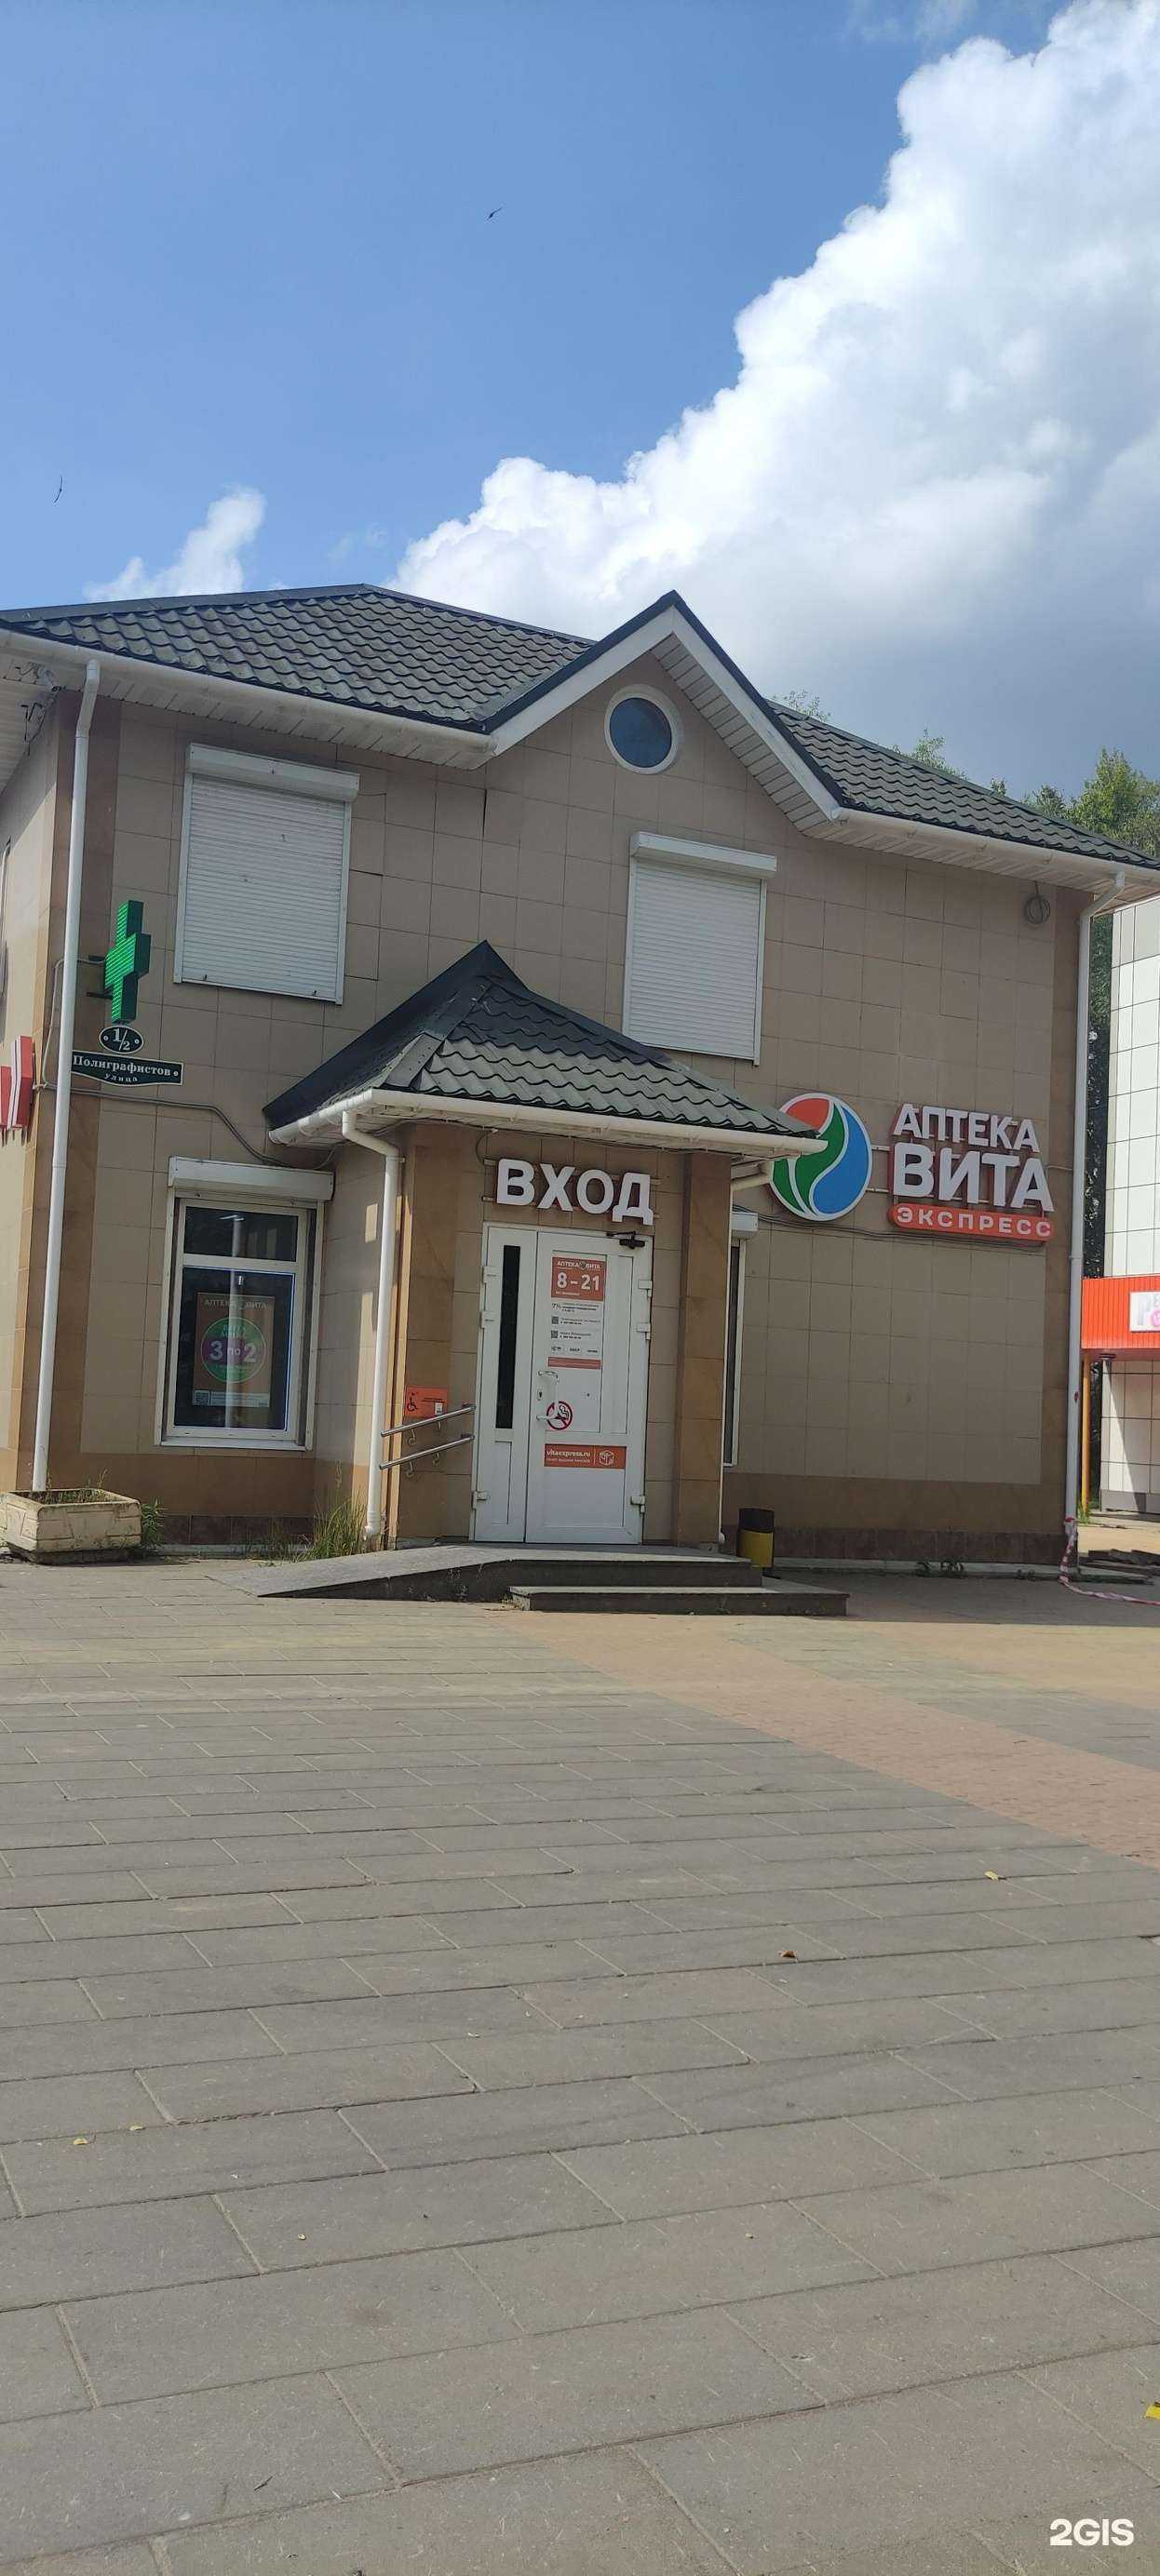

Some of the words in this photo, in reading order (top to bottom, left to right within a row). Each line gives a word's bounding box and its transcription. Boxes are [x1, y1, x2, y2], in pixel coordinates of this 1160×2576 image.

[73, 1054, 171, 1077] Полиграфистов
[104, 1073, 138, 1083] улица
[893, 1103, 1041, 1153] АПТЕКА
[496, 1158, 654, 1226] ВХОД
[893, 1142, 1055, 1212] ВИТА
[897, 1207, 1052, 1238] ЭКСПРЕСС
[209, 1340, 223, 1361] 3
[244, 1343, 256, 1362] 2
